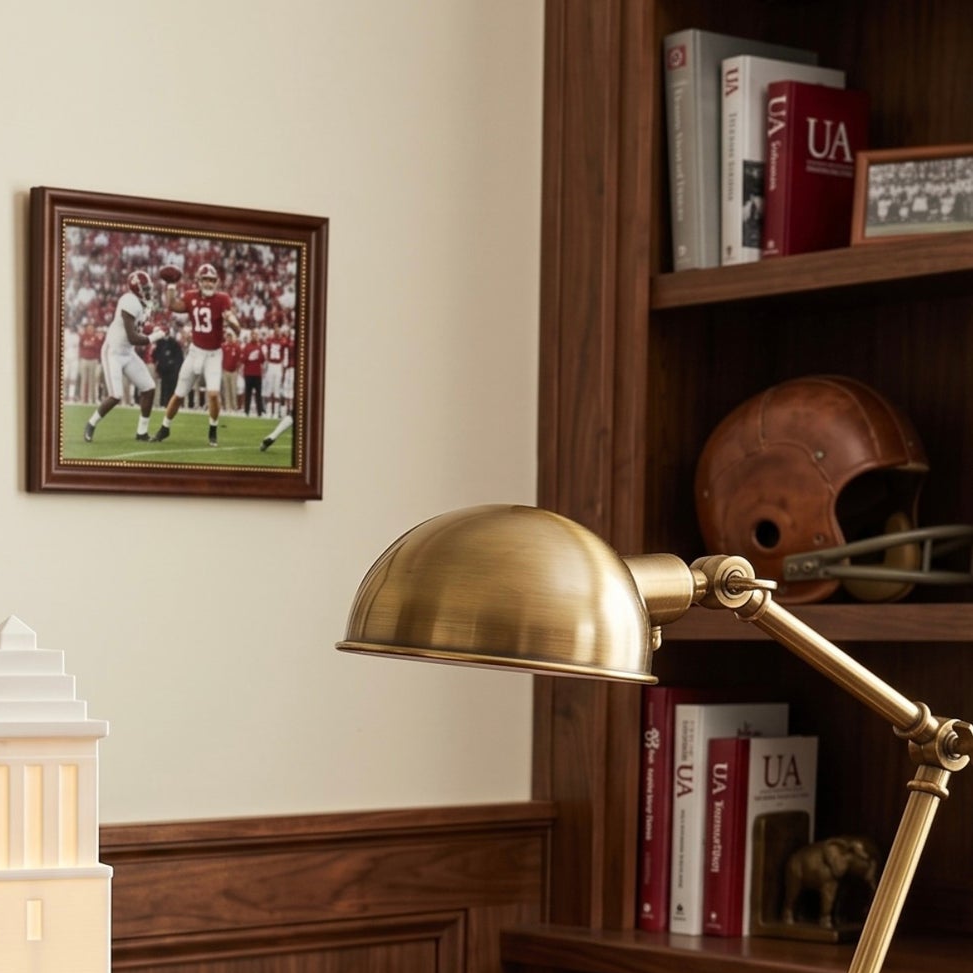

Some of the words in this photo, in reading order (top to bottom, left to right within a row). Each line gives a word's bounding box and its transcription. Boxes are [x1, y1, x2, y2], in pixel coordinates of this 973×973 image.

[767, 95, 787, 137] UA
[806, 116, 853, 163] UA
[193, 306, 213, 333] 13
[676, 764, 694, 799] UA
[712, 762, 728, 795] UA
[761, 753, 803, 789] UA
